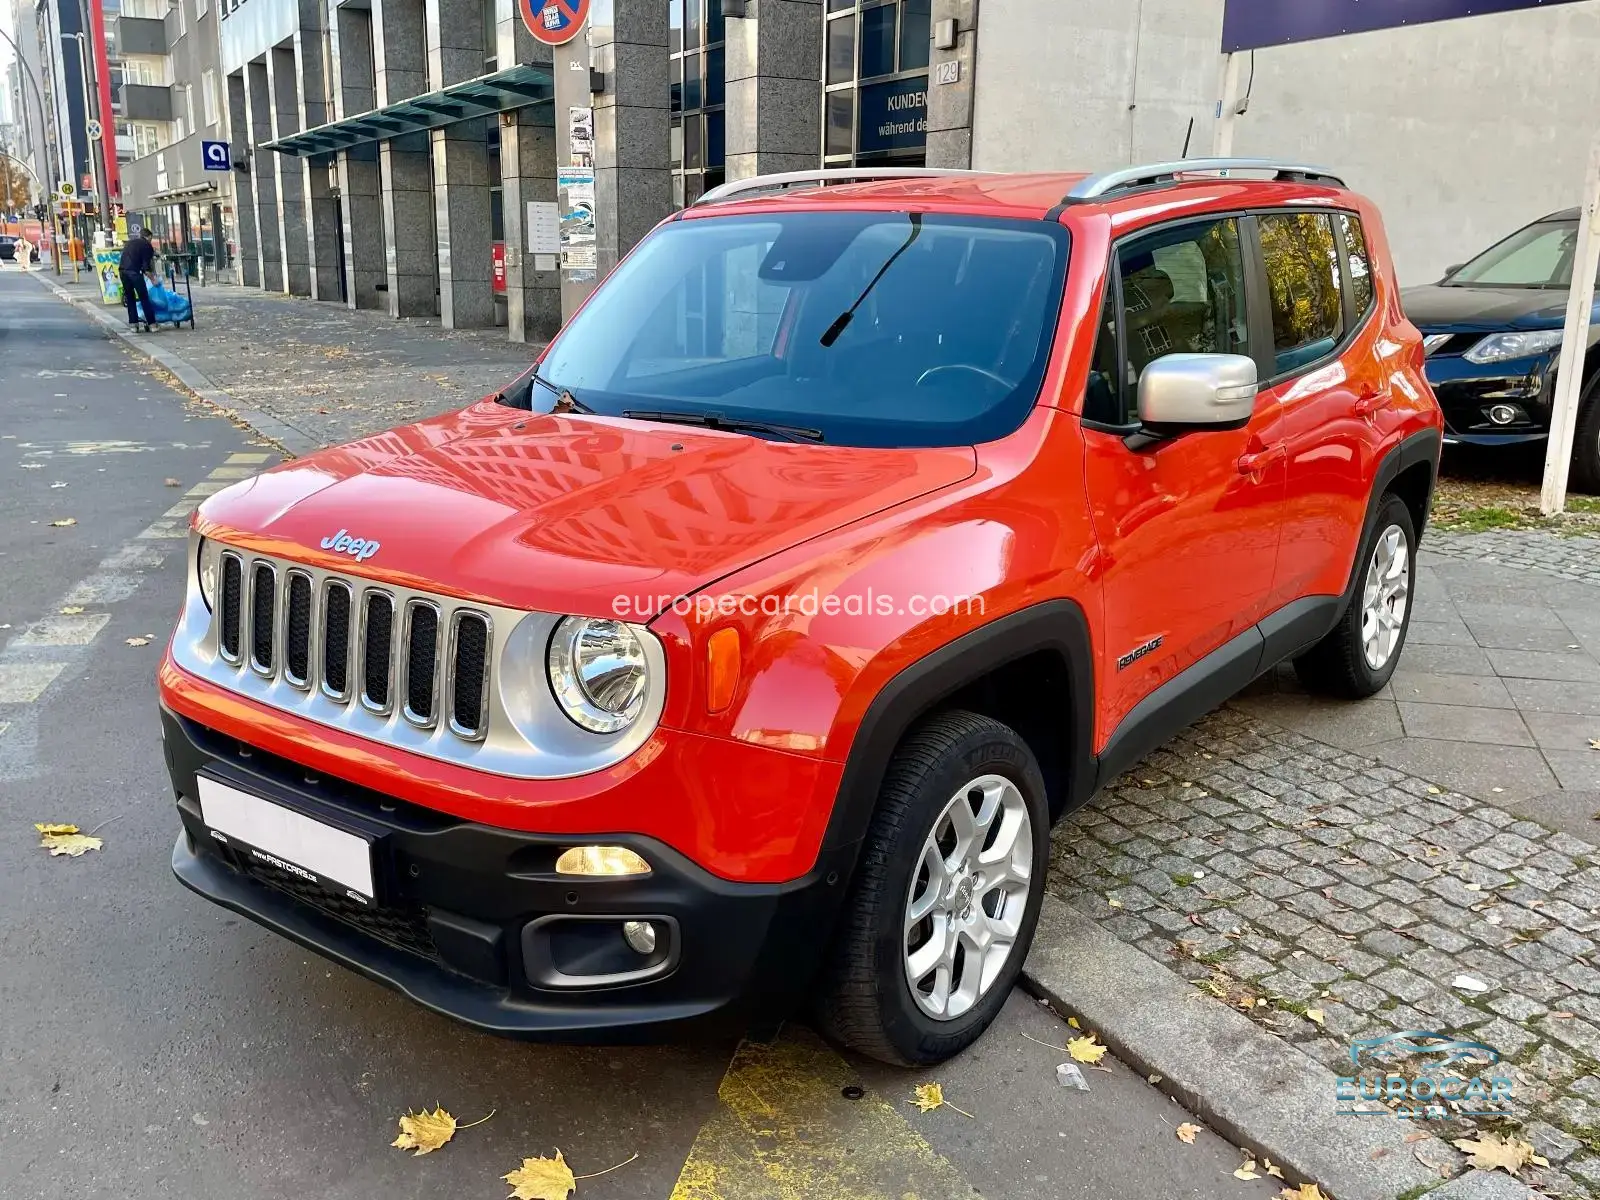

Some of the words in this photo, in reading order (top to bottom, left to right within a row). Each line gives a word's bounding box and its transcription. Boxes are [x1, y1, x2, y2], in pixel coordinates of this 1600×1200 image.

[937, 62, 957, 83] 129
[887, 90, 928, 111] KUNDEN
[879, 119, 915, 136] während
[320, 528, 380, 563] Jeep
[1116, 635, 1164, 673] RENEGADE
